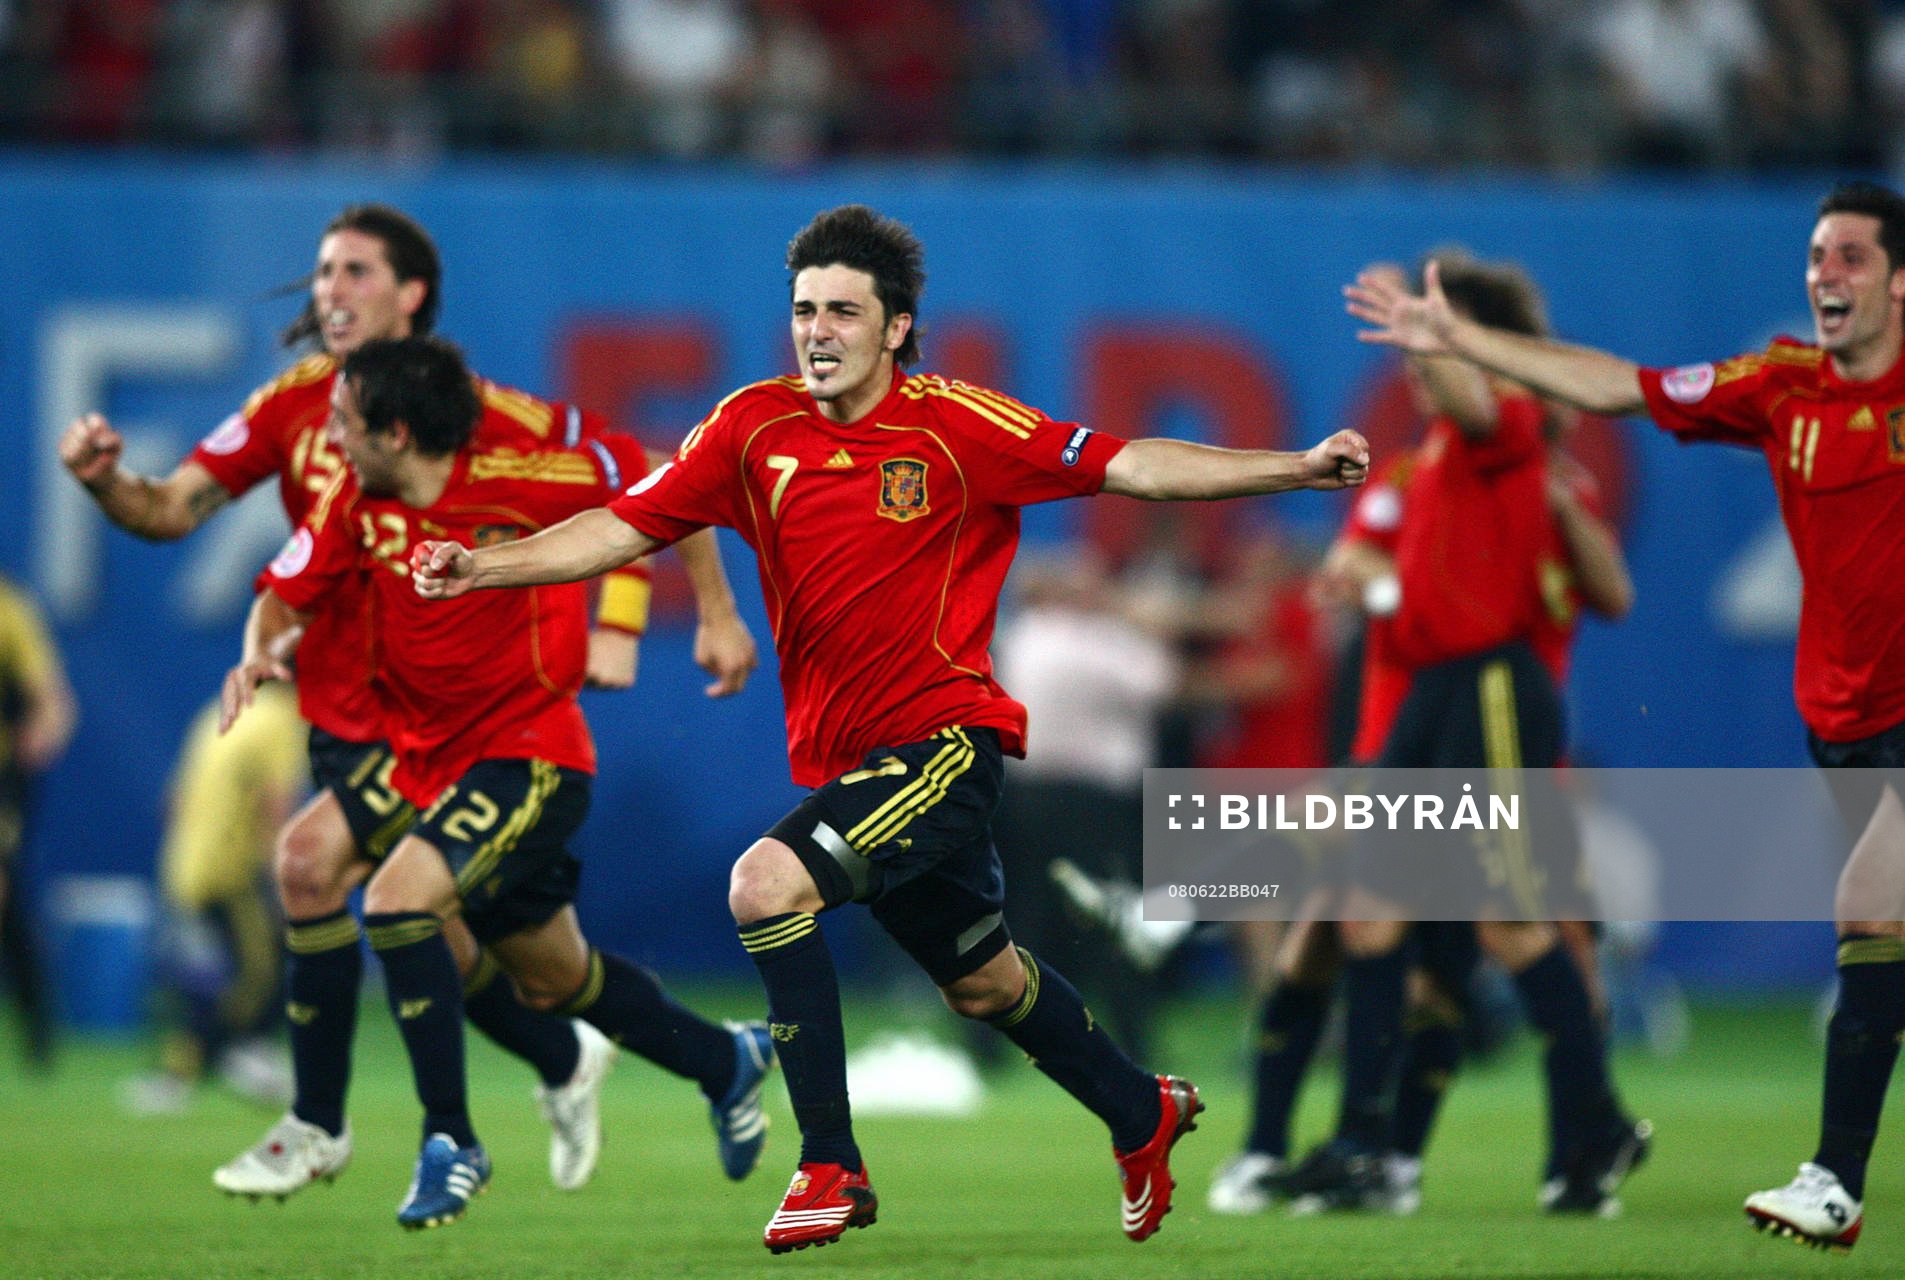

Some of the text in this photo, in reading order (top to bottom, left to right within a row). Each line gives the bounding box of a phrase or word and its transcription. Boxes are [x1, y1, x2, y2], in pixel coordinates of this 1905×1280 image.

[291, 426, 344, 493] 15
[1789, 414, 1821, 483] 11
[766, 455, 799, 520] 7
[360, 512, 409, 577] 12
[347, 748, 402, 816] 15
[840, 756, 908, 785] 7
[421, 784, 500, 843] 12
